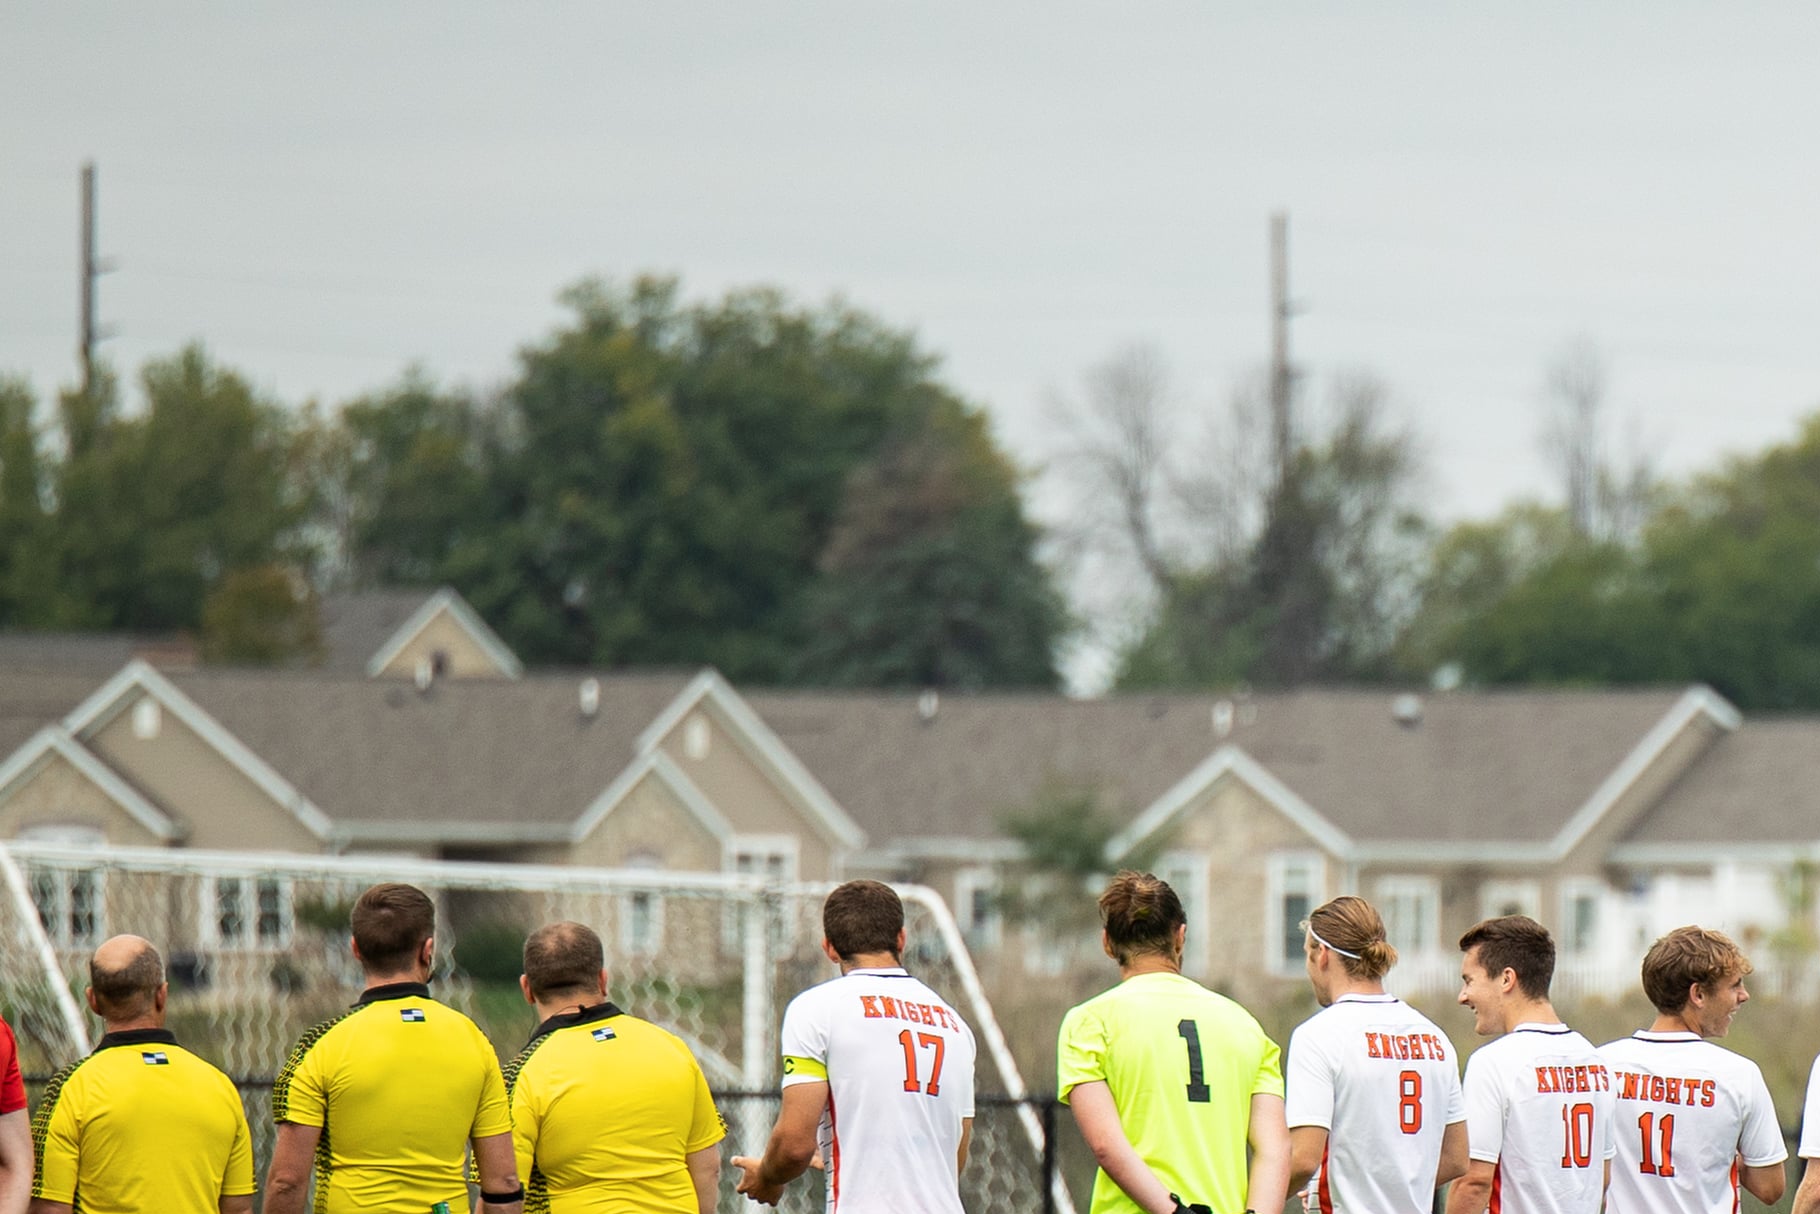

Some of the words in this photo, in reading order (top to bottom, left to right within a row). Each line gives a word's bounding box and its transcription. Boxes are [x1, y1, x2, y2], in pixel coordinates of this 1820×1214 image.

[860, 996, 959, 1033] KNIGHTS
[1365, 1032, 1445, 1061] KNIGHTS
[898, 1029, 945, 1097] 17
[1177, 1019, 1210, 1102] 1
[1535, 1065, 1609, 1093] KNIGHTS
[1399, 1070, 1422, 1135] 8
[1561, 1102, 1594, 1168] 10
[1638, 1111, 1675, 1178] 11
